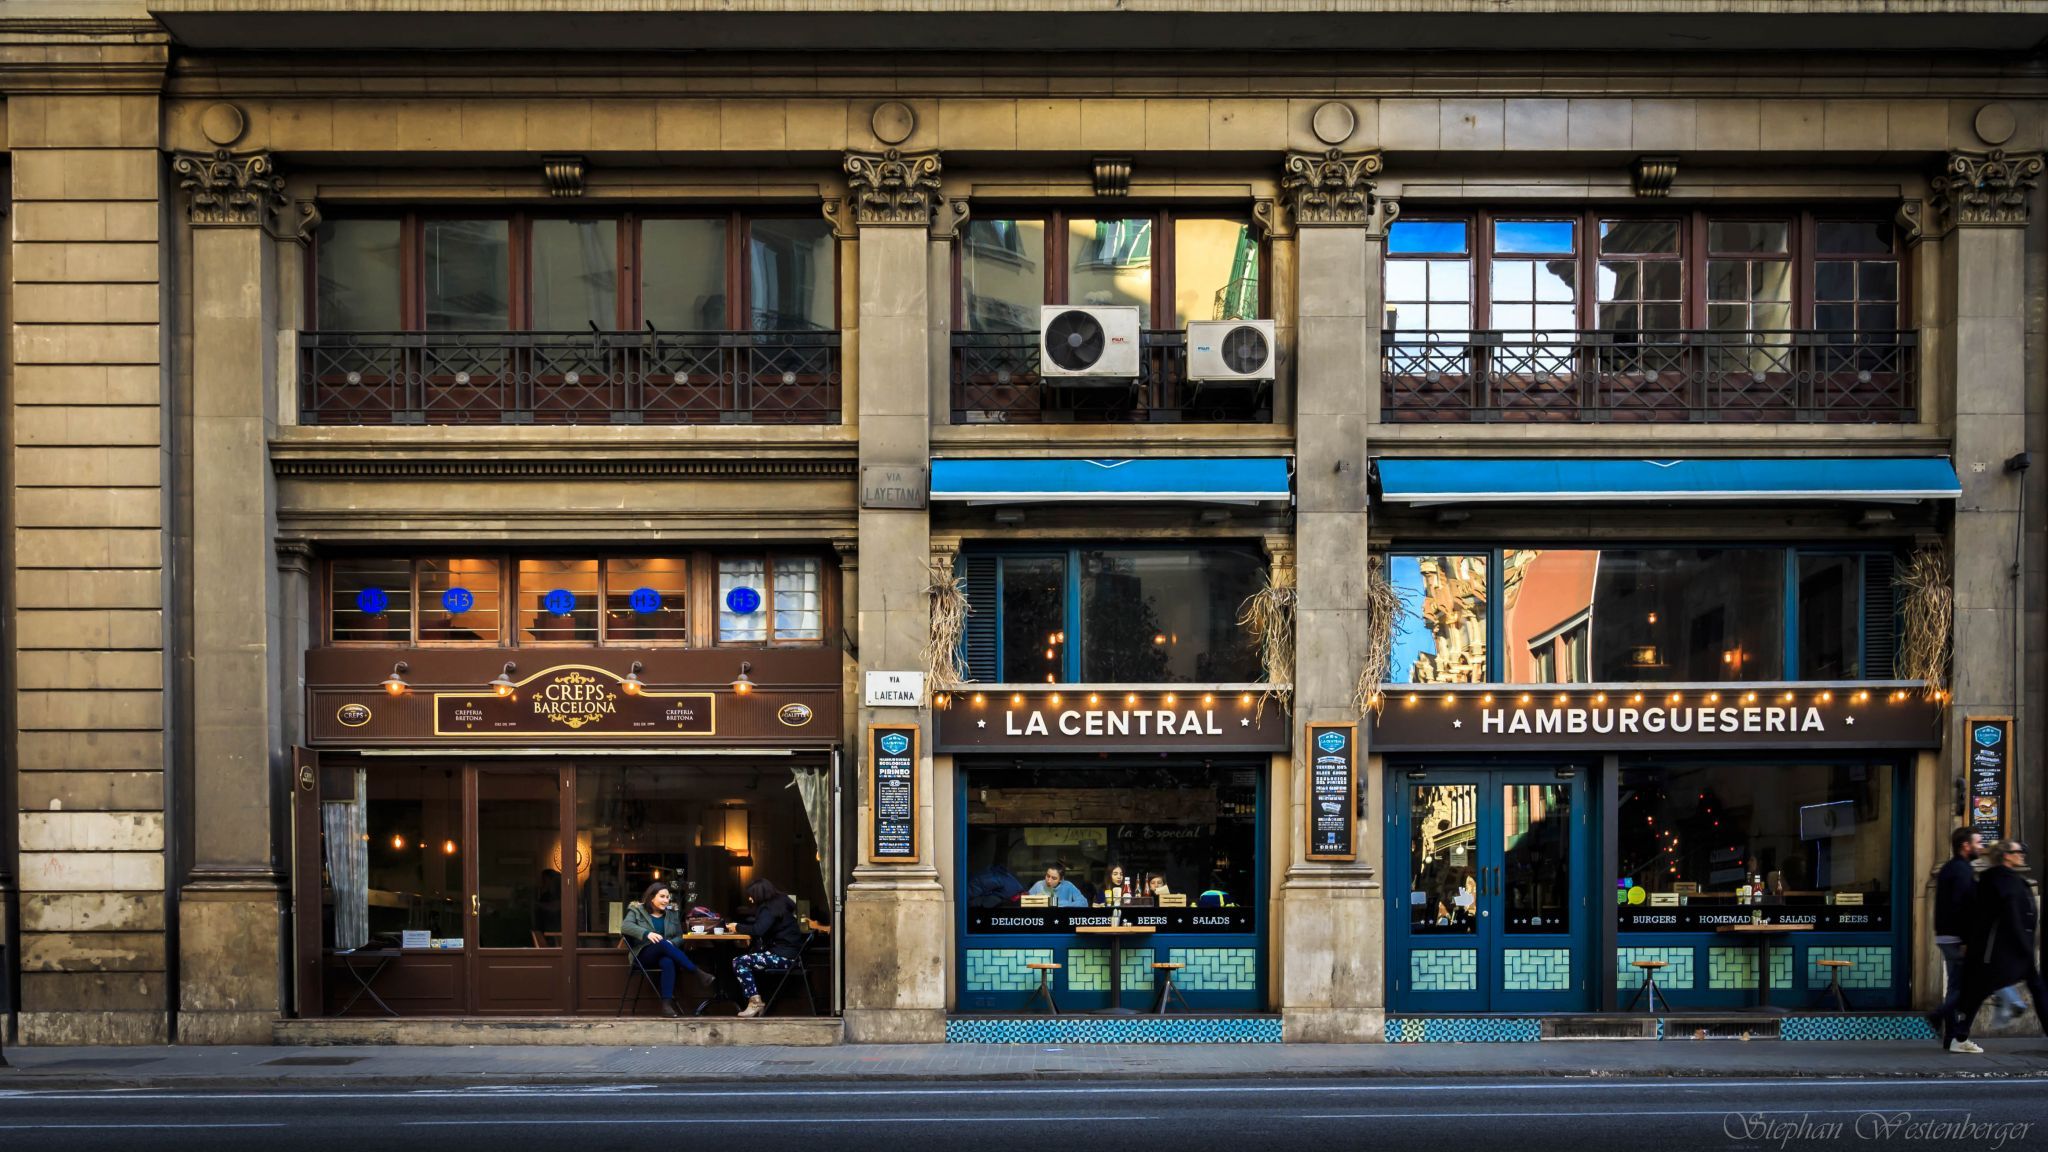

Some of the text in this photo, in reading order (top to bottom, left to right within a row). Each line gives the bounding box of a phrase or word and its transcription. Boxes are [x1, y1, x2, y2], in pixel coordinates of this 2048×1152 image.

[886, 472, 902, 481] VIA
[866, 487, 920, 501] LAYETANA
[545, 684, 604, 701] CREPS
[874, 690, 915, 701] LAIETANA
[534, 701, 616, 714] BARCELONA
[1006, 710, 1223, 736] LA CENTRAL
[1481, 706, 1825, 734] HAMBURGUESERIA
[991, 917, 1044, 926] DELICIOUS
[1137, 916, 1168, 925] BEERS
[1192, 916, 1230, 925] SALADS
[1632, 915, 1677, 924] BURGERS
[1779, 915, 1817, 924] SALADS
[1839, 915, 1869, 923] BEERS
